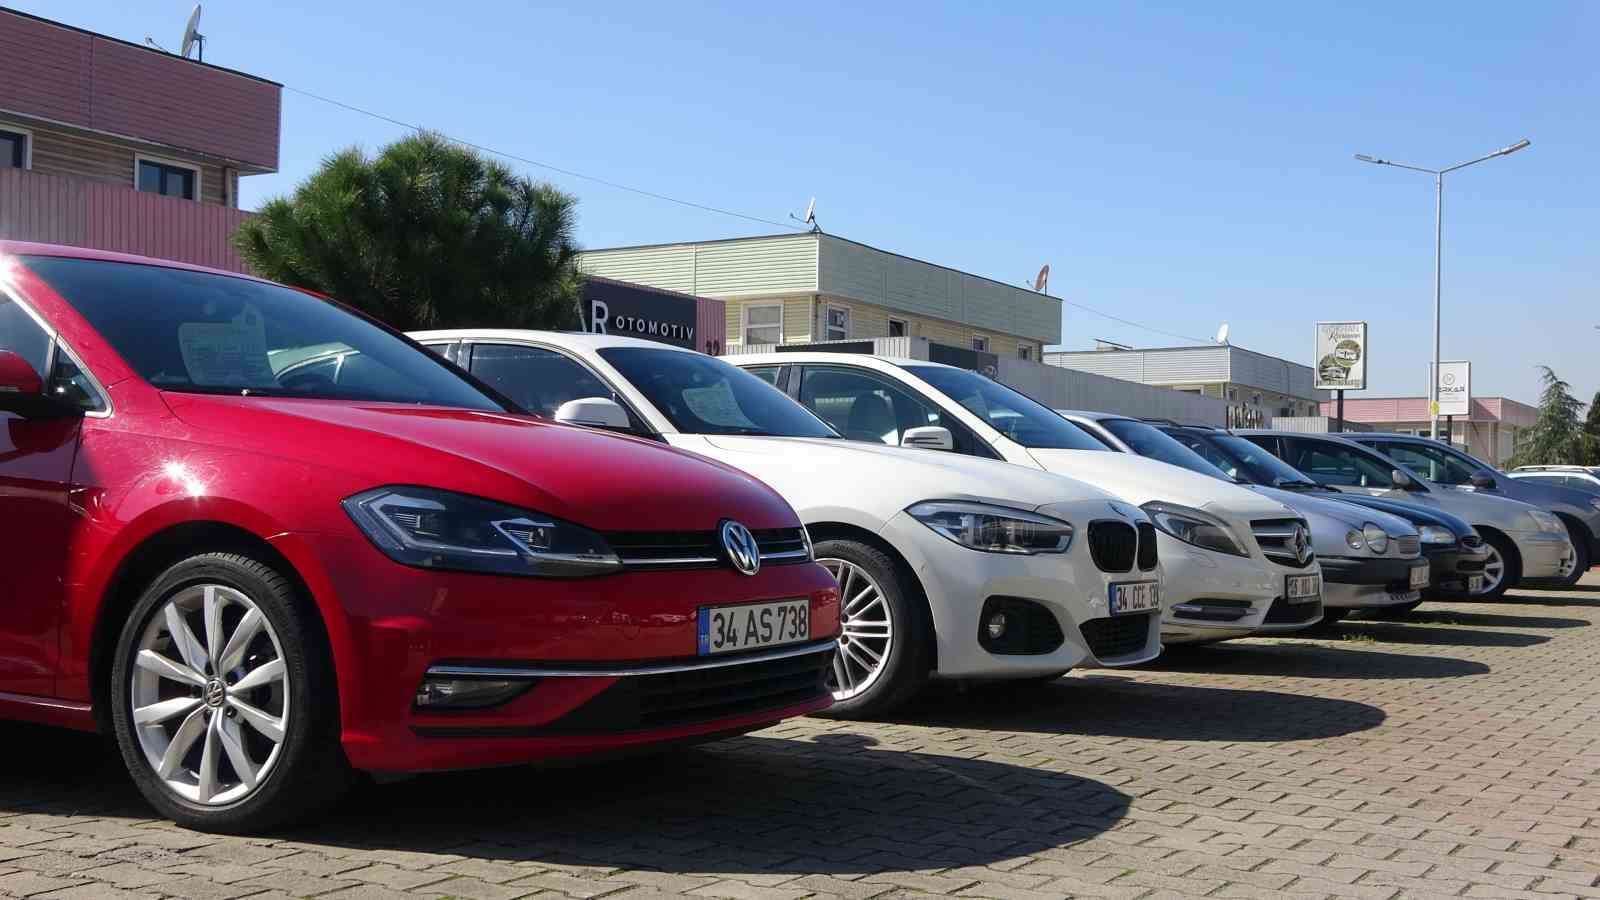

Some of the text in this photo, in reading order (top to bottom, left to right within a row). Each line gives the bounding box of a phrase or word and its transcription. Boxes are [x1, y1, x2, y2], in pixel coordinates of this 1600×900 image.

[713, 612, 738, 649] 34
[744, 608, 773, 646] AS
[778, 605, 808, 640] 738
